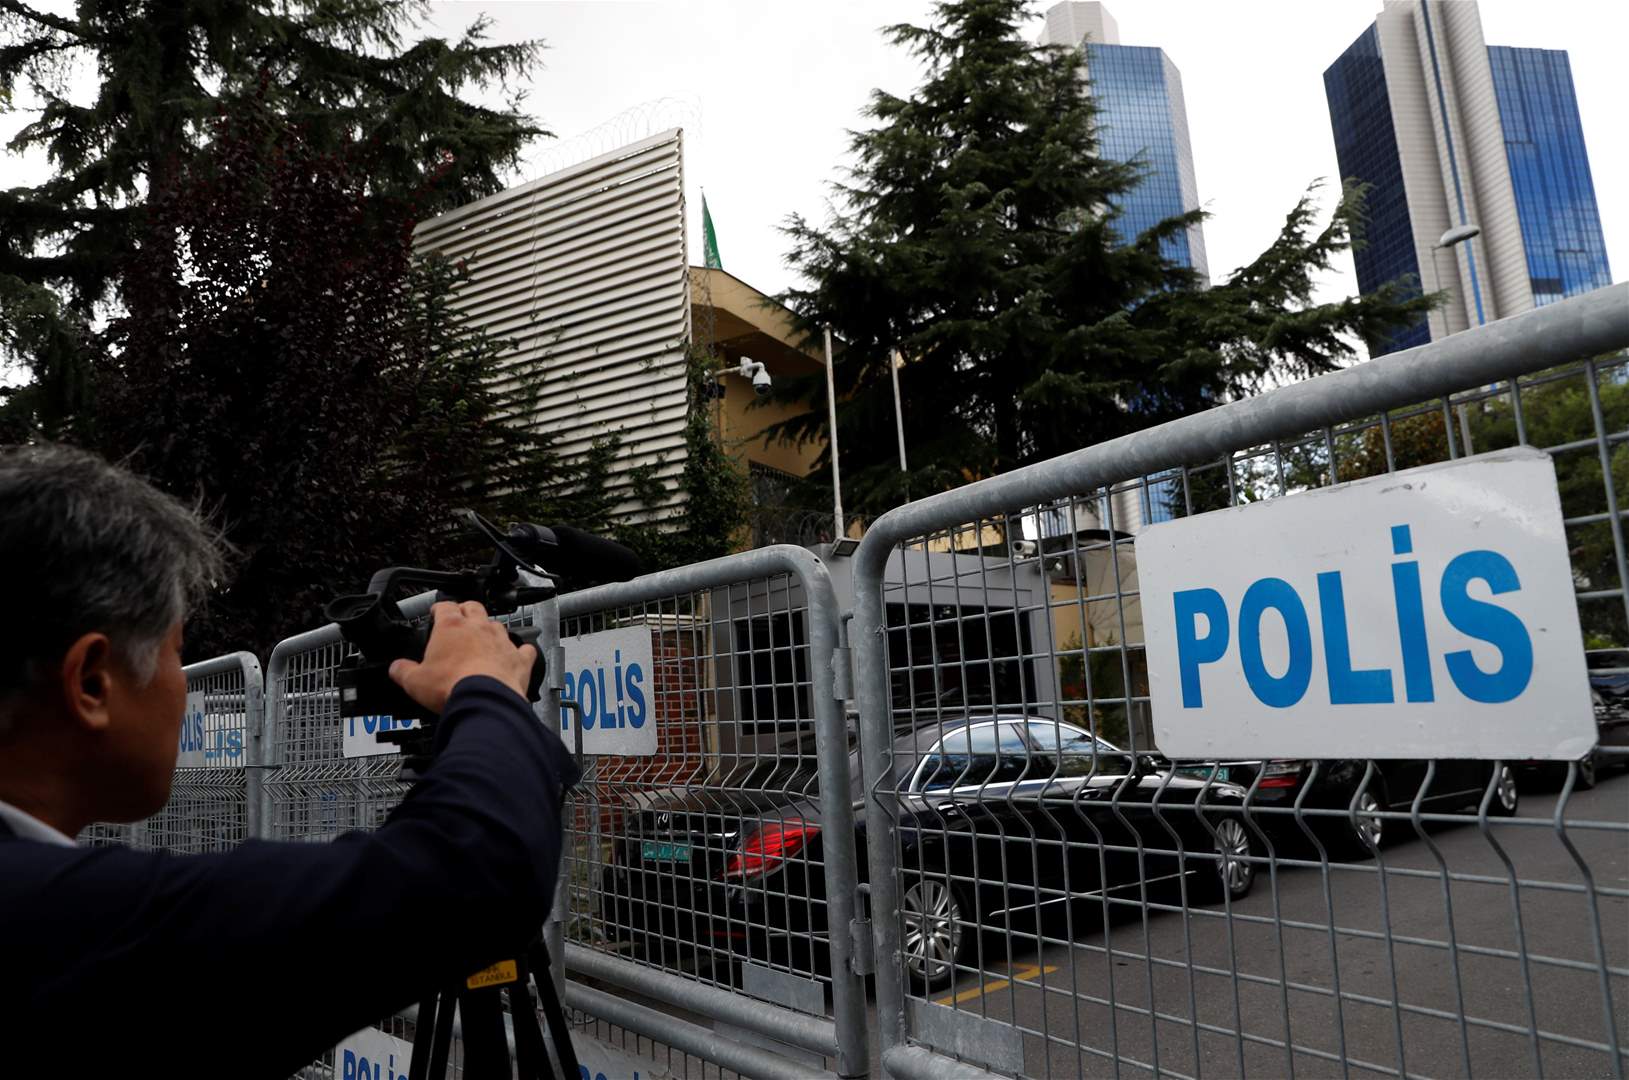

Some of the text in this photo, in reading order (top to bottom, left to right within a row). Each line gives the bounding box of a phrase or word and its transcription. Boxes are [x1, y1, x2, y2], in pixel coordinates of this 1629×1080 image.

[1173, 524, 1534, 709] POLİS
[180, 703, 203, 753] OLİS
[561, 649, 646, 731] POLİS
